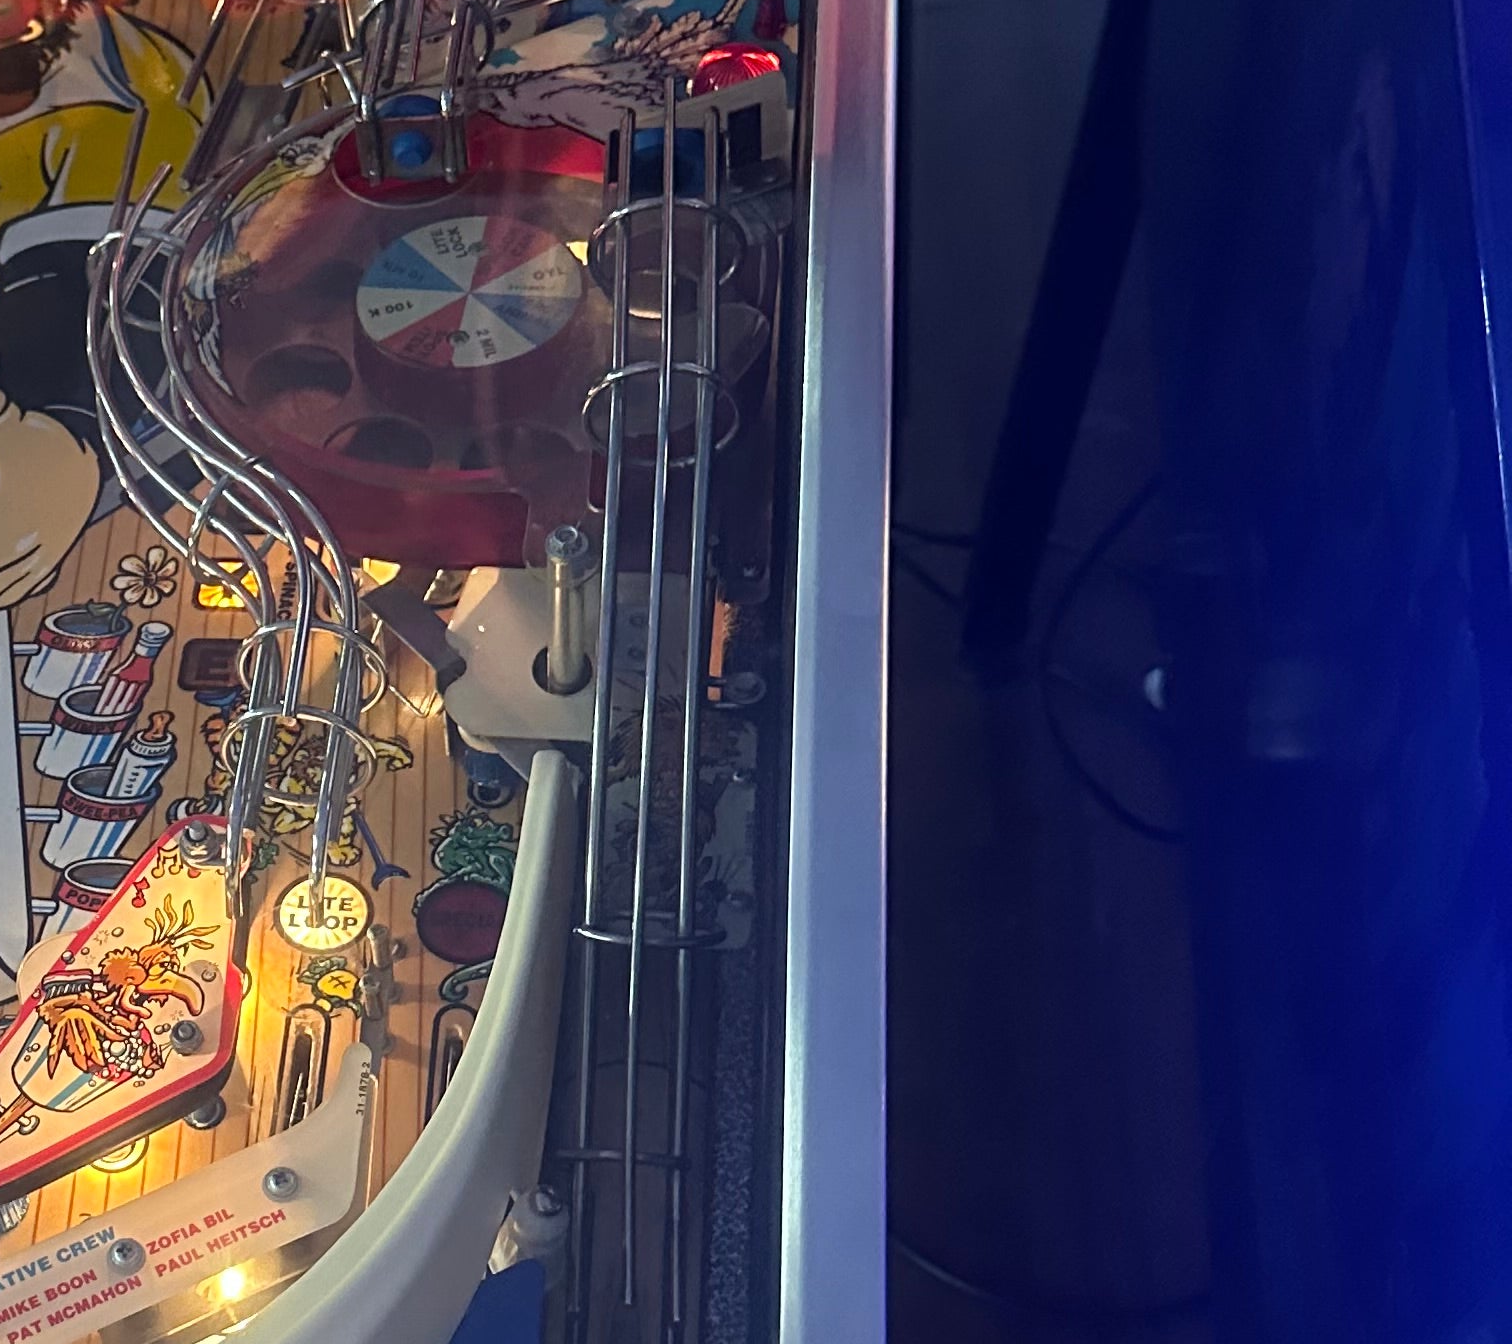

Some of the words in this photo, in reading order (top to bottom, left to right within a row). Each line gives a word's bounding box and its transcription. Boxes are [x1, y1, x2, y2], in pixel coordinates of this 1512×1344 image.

[386, 300, 414, 315] 100
[277, 561, 297, 620] SPINAC
[66, 889, 108, 907] POP
[297, 896, 354, 912] LTE
[44, 1269, 98, 1303] BOON
[145, 1222, 202, 1255] ZOFIA
[204, 1207, 235, 1234] BIL
[47, 1275, 142, 1327] MCMAHON
[154, 1248, 202, 1279] PAUL
[206, 1209, 288, 1258] HEITSCH
[55, 1226, 117, 1268] CREW
